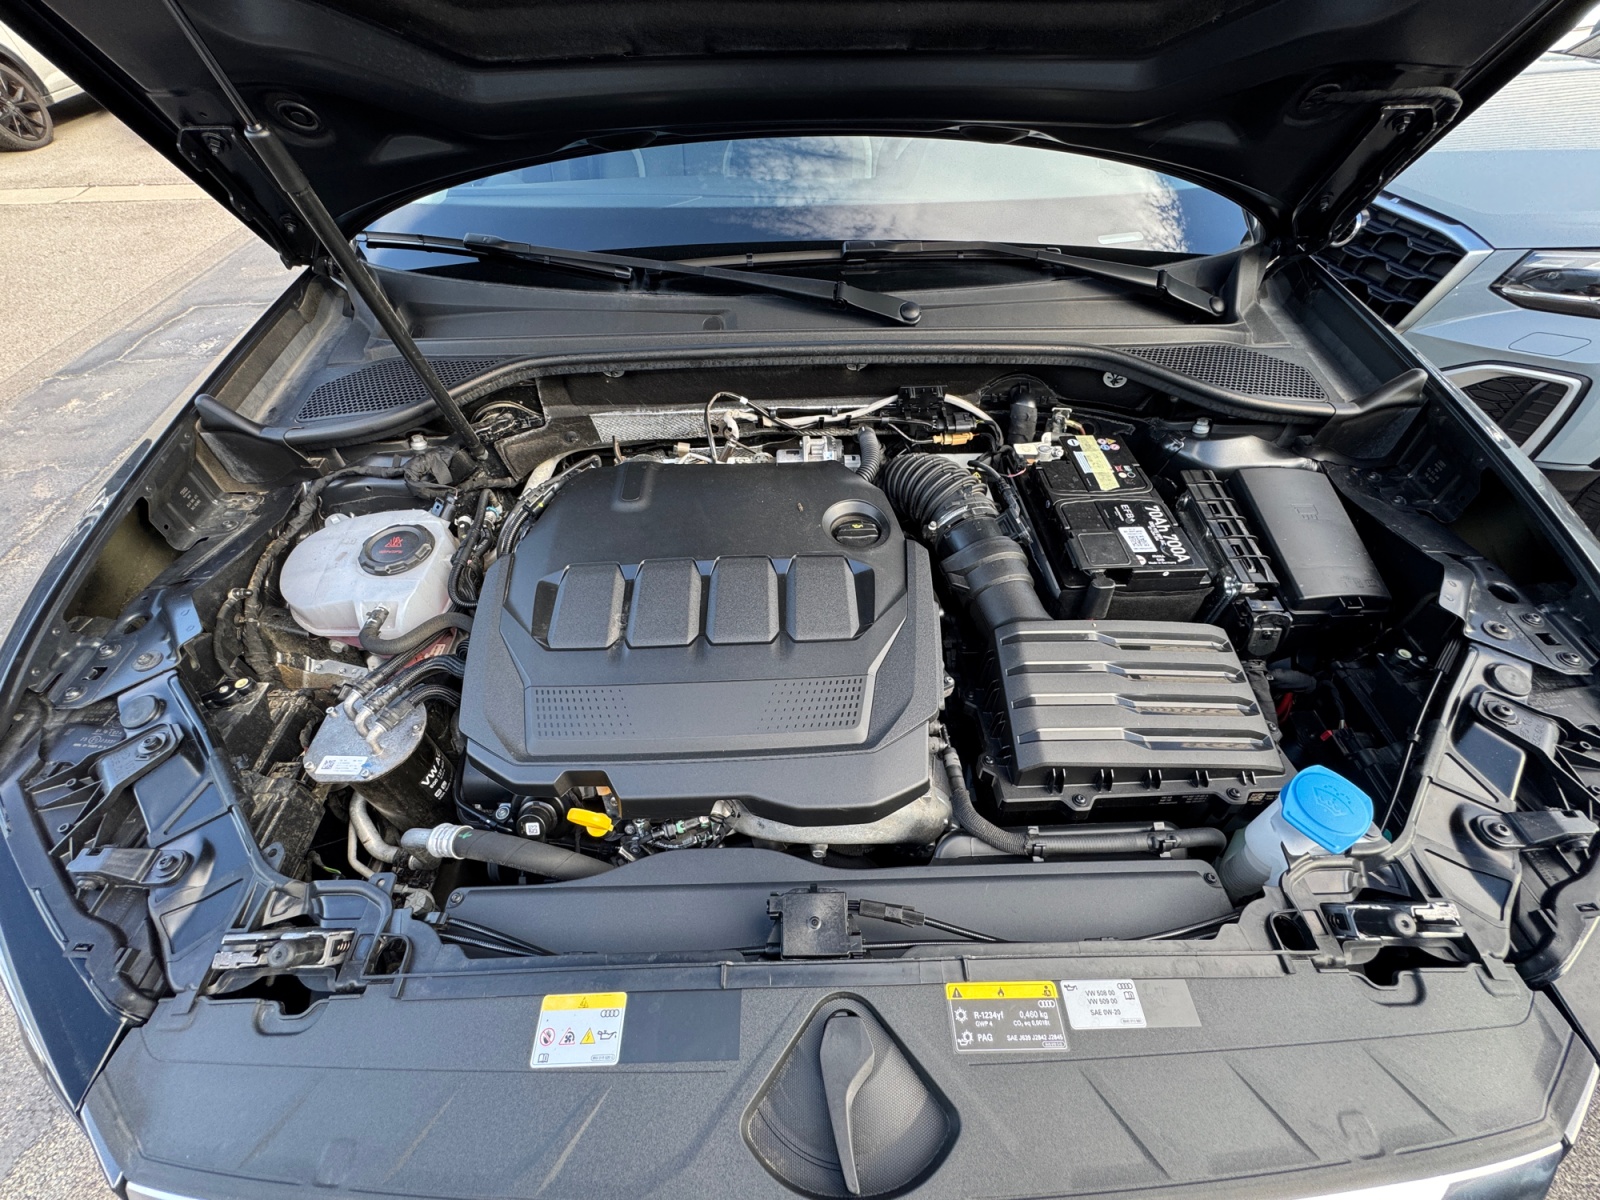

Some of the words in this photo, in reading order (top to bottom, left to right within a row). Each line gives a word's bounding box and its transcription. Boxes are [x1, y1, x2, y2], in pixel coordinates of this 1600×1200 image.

[1144, 505, 1171, 532] 70Ah
[1163, 534, 1191, 563] 700A
[421, 765, 438, 786] VW
[973, 1010, 1004, 1020] R-1234yf
[1039, 1010, 1049, 1020] kg
[977, 1033, 993, 1042] PAG
